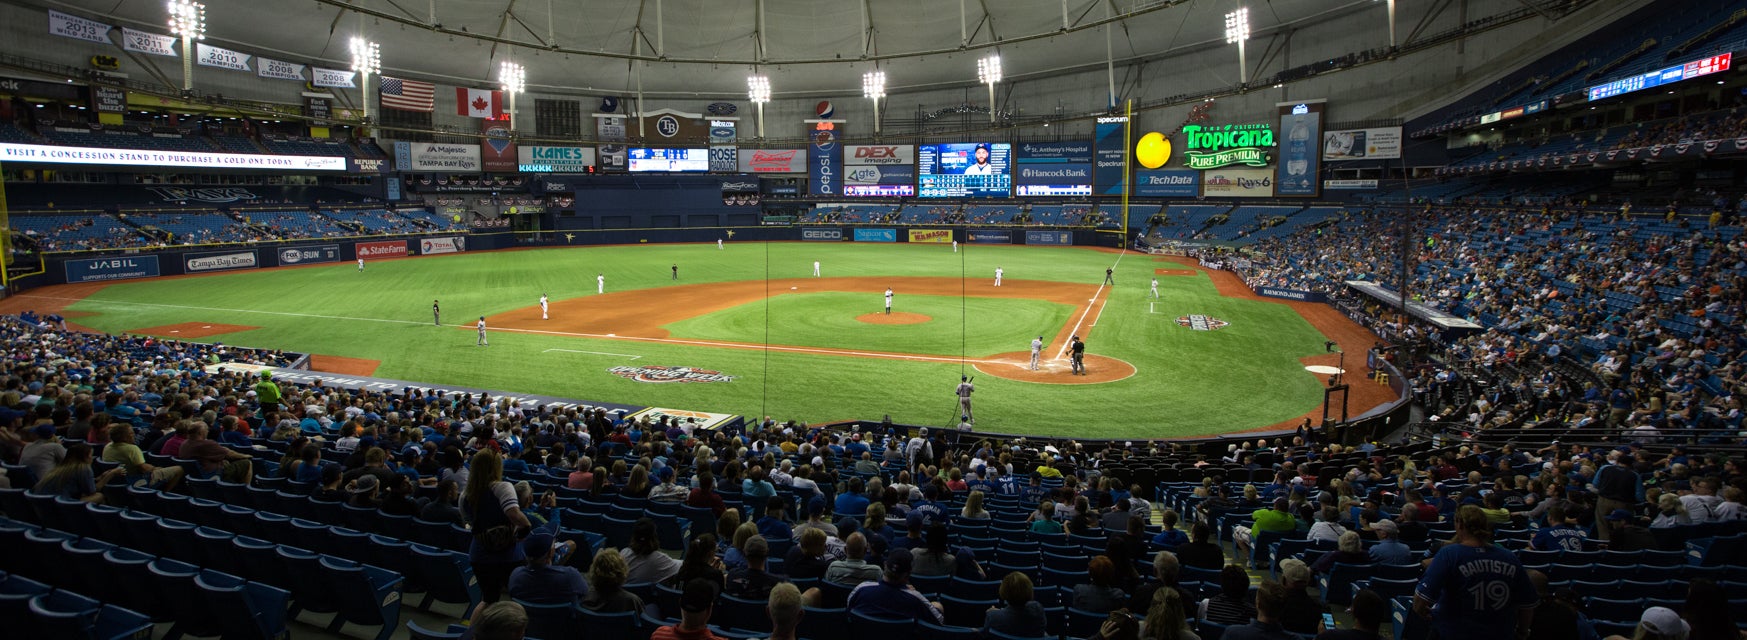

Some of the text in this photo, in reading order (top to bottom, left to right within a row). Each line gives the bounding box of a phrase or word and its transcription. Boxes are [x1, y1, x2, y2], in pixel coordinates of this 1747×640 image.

[65, 21, 96, 35] 2013
[57, 27, 103, 42] WILD CARD
[137, 37, 162, 48] 2011
[209, 52, 238, 63] 2010
[201, 57, 244, 70] CHAMPIONS
[268, 64, 293, 74] 2008
[261, 70, 299, 80] CHAMPIONS
[323, 73, 345, 82] 2008
[316, 79, 350, 87] CHAMPIONS
[97, 91, 123, 99] heard
[98, 103, 124, 111] buzz?
[661, 119, 676, 134] TB
[1182, 125, 1273, 151] Tropicana
[438, 146, 467, 155] Majestic
[532, 147, 583, 160] KANE'S
[711, 148, 737, 161] ROSE
[855, 147, 898, 158] DEX
[1066, 146, 1088, 154] Hospital
[6, 148, 35, 157] VISIT
[51, 150, 116, 160] CONCESSION
[119, 153, 149, 161] STAND
[168, 155, 212, 164] PURCHASE
[224, 157, 246, 165] COLD
[1190, 150, 1260, 166] PURE PREMIUM
[458, 160, 475, 170] Rays
[711, 161, 737, 171] RADIOLOGY
[818, 153, 833, 194] pepsi
[859, 169, 875, 179] gte
[1237, 177, 1260, 190] Rays
[1261, 177, 1270, 187] 6
[803, 231, 841, 239] GEICO
[303, 250, 319, 259] SUN
[90, 260, 137, 269] JABIL
[191, 255, 252, 269] Tampa Bay Times
[83, 273, 107, 281] SUPPORTS
[1263, 289, 1288, 297] RAYMOND
[367, 381, 398, 389] TO
[1002, 483, 1015, 494] 11
[918, 506, 941, 516] STROMAN
[1558, 537, 1582, 551] 19
[1458, 559, 1517, 578] BAUTISTA
[1467, 580, 1510, 611] 19
